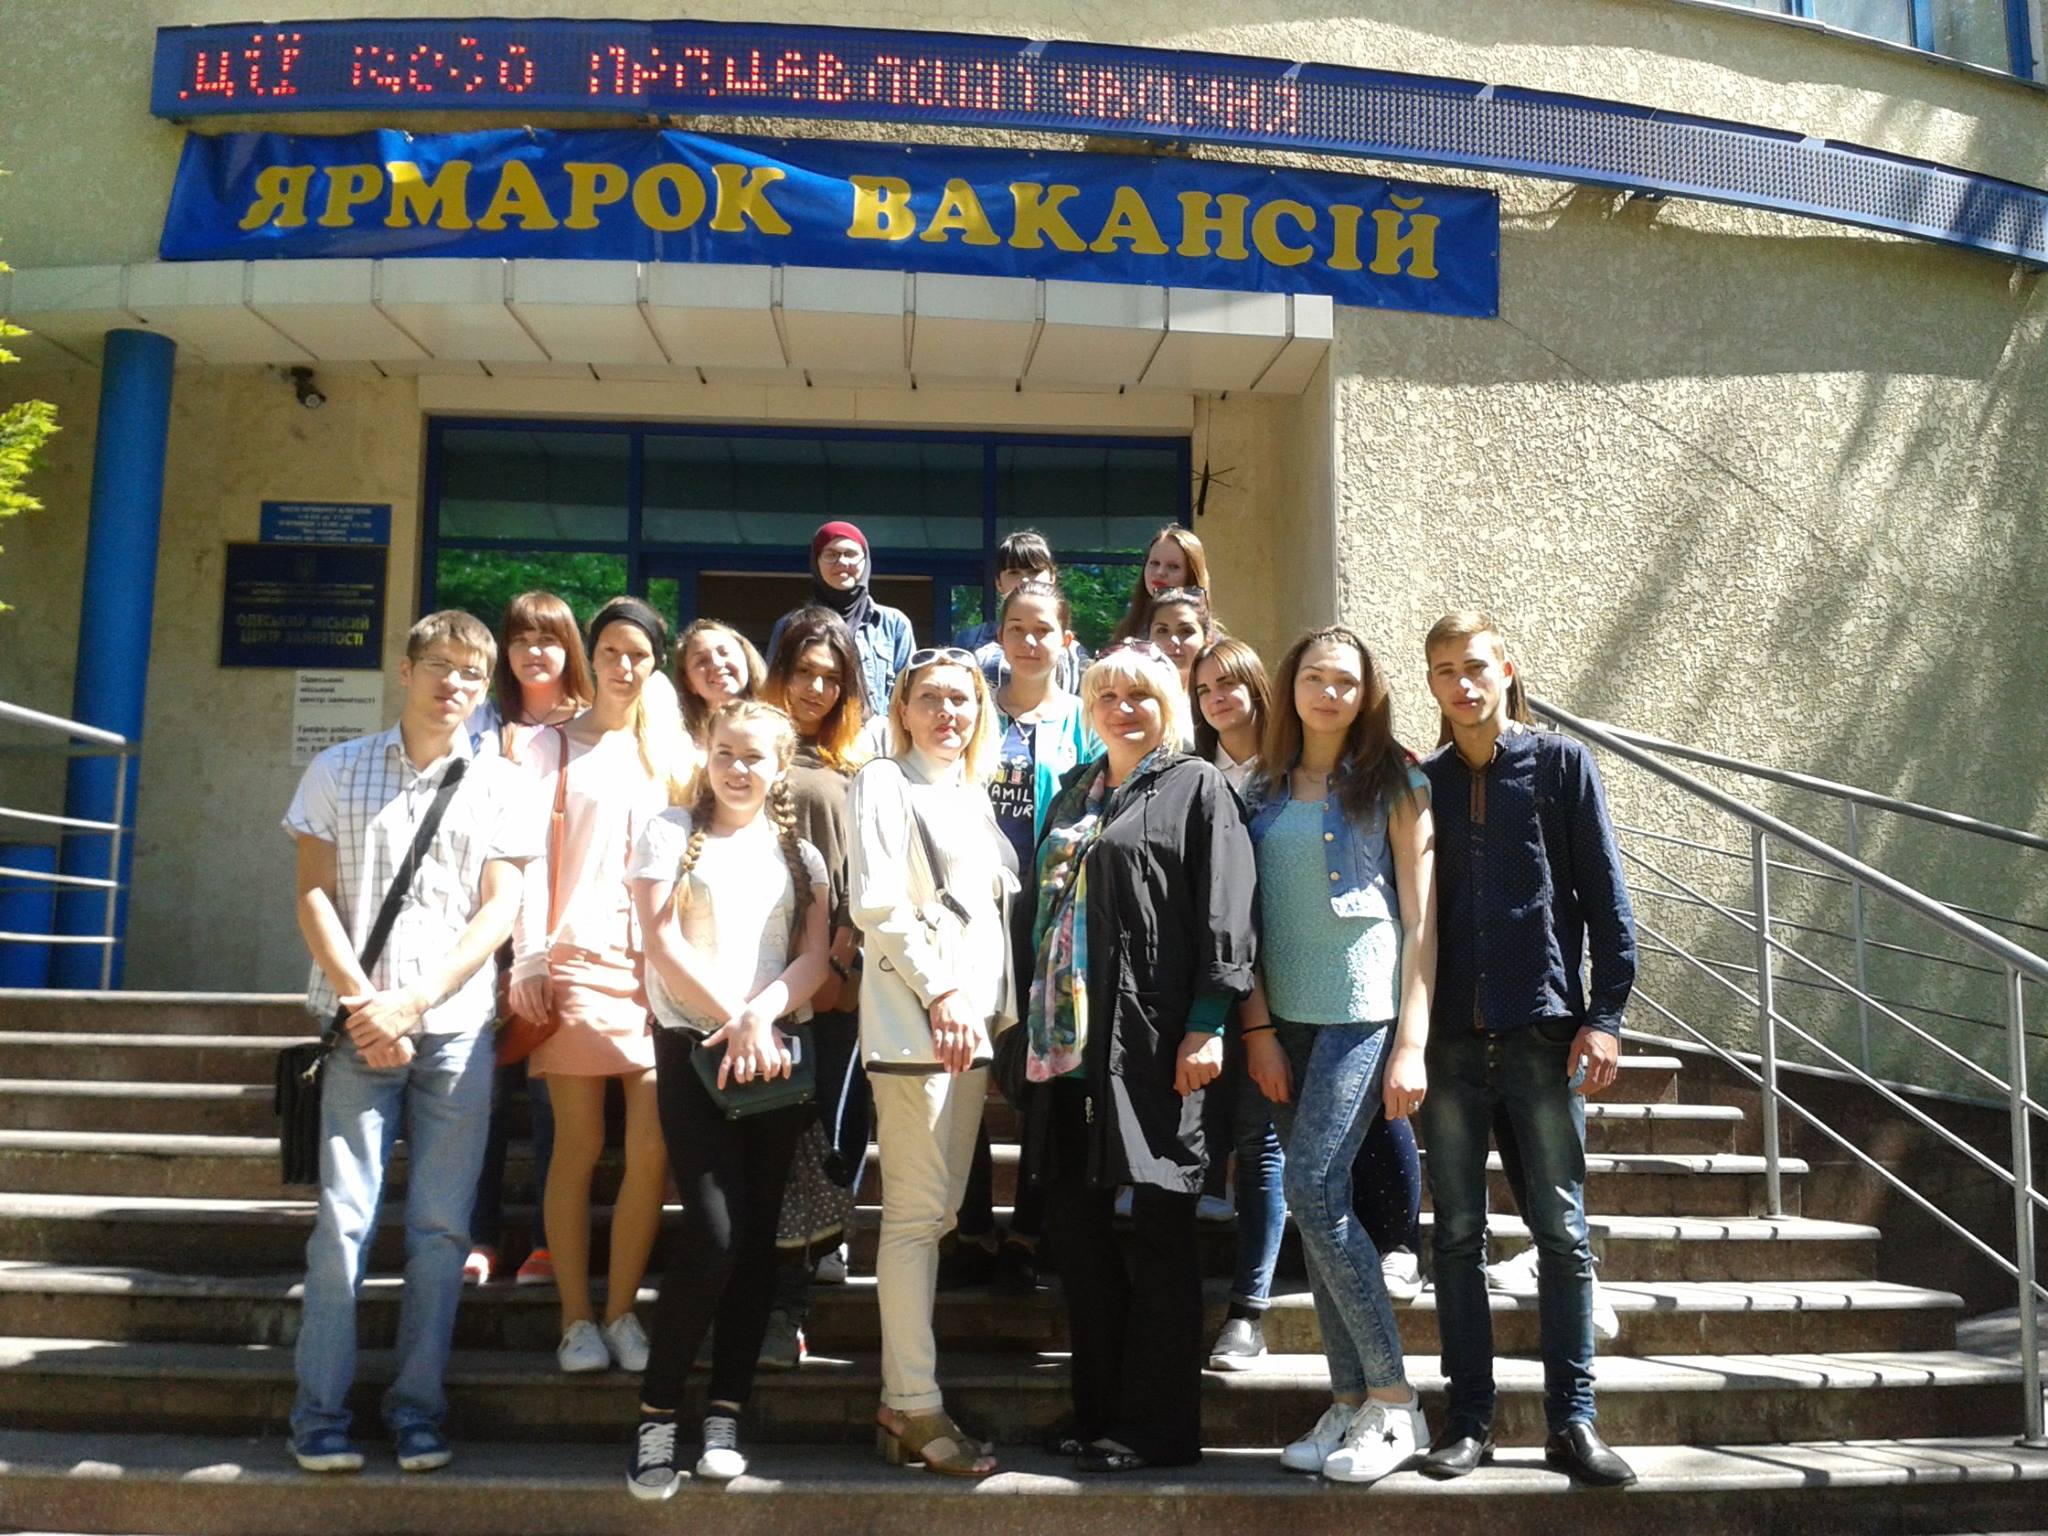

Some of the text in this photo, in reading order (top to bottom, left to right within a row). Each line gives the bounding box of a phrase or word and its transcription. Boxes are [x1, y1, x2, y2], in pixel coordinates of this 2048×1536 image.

[239, 160, 1441, 280] ЯРМАРОК ВАКАНСІЙ
[992, 801, 1034, 818] TUR
